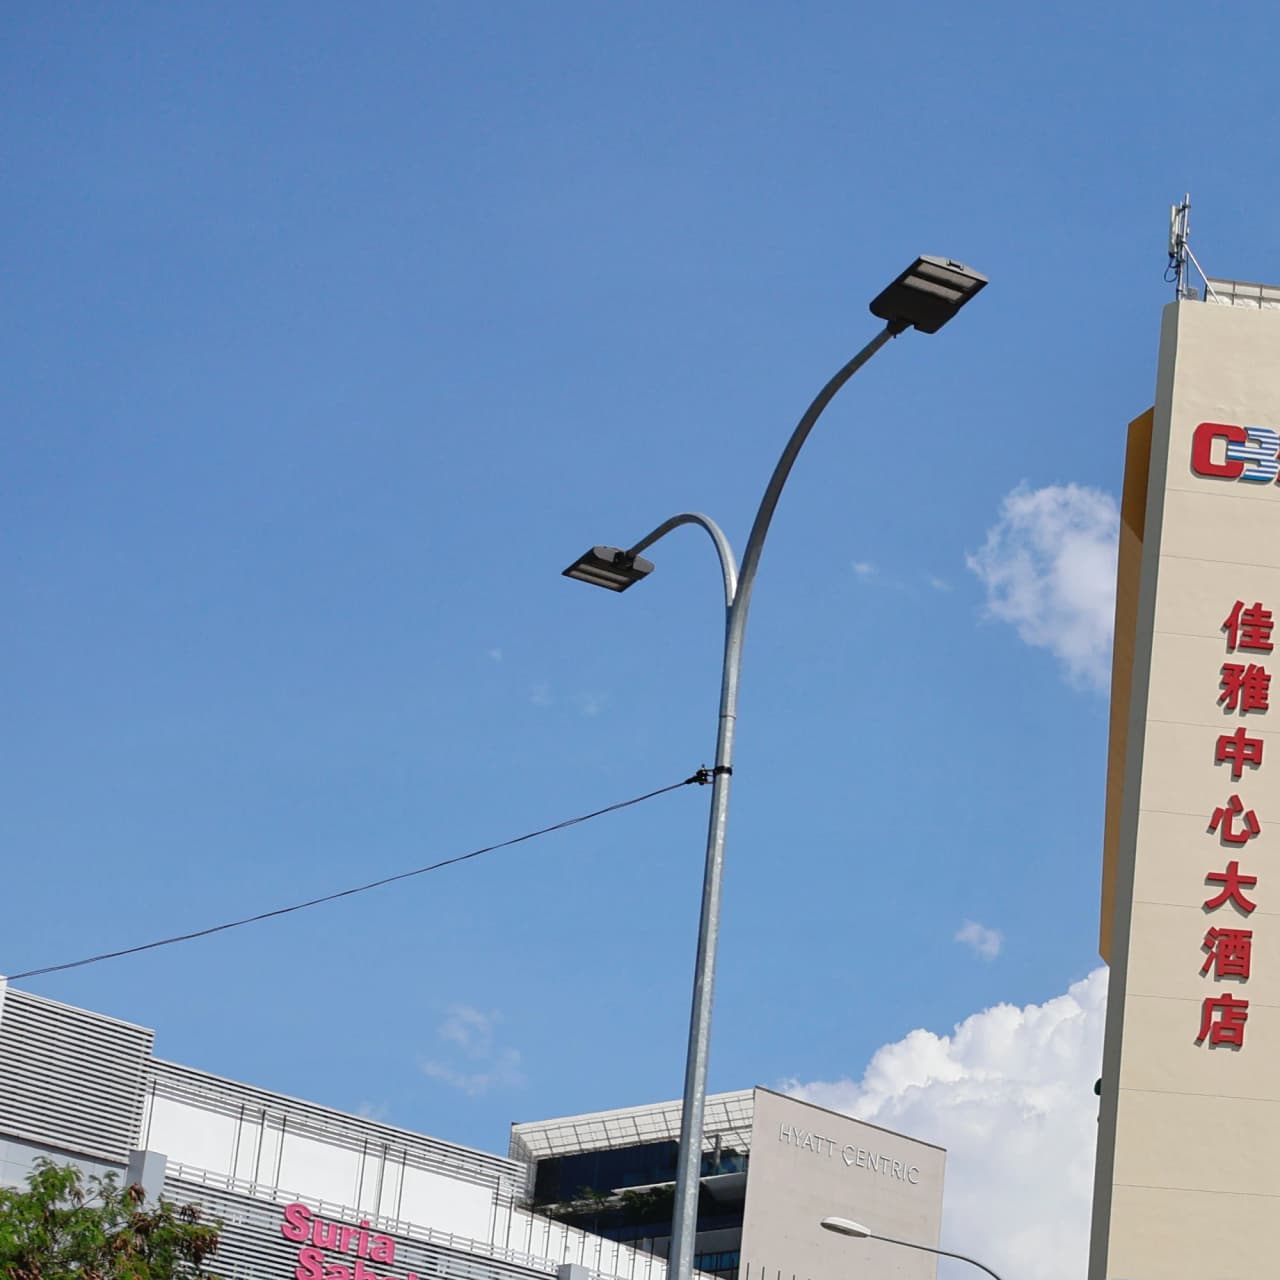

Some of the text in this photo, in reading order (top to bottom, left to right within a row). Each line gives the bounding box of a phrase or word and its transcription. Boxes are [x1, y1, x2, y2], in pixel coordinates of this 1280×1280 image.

[1194, 600, 1275, 1048] 佳雅中心大酒店
[779, 1122, 920, 1185] HYATT CENTRIC
[280, 1203, 395, 1265] Suria
